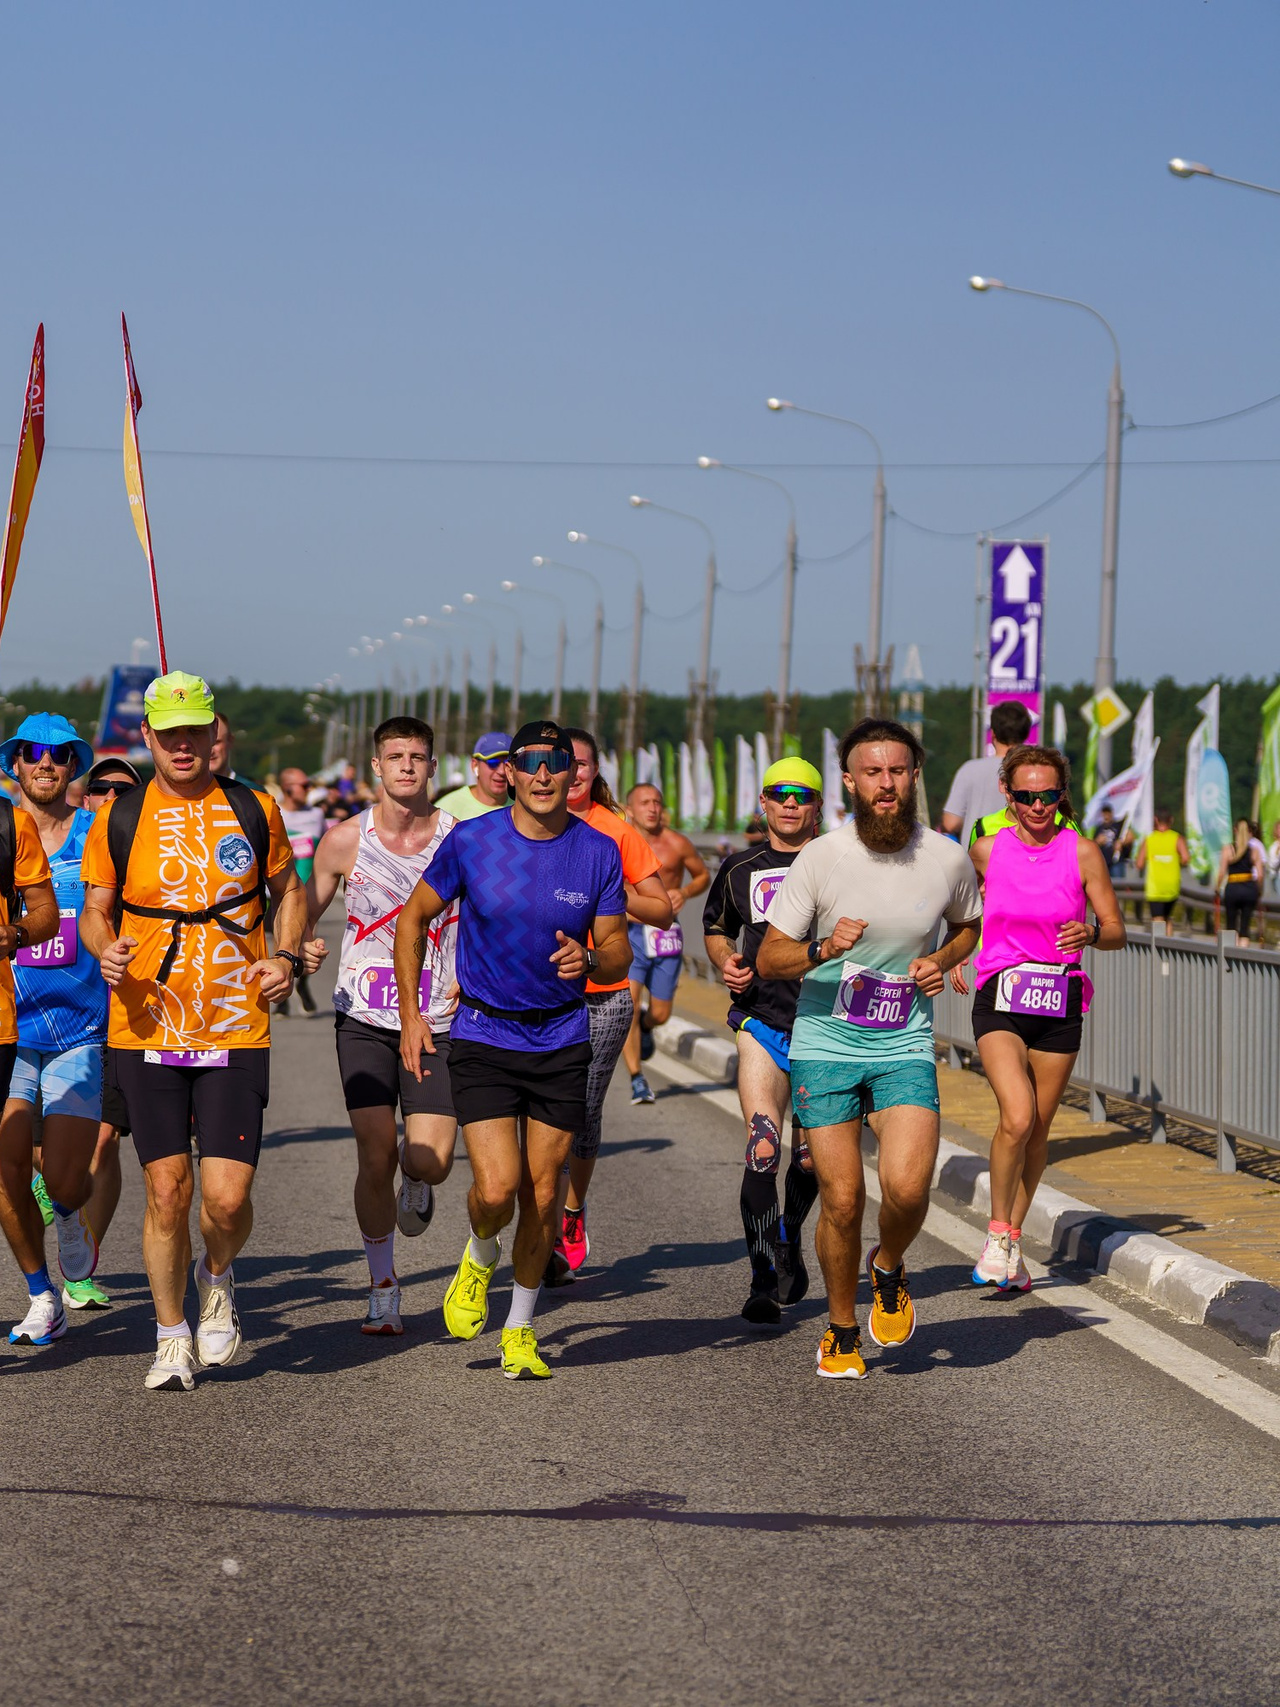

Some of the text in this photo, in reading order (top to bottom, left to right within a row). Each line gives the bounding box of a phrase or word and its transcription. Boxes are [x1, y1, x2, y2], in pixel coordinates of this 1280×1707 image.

[990, 615, 1038, 679] 21
[154, 807, 189, 974] КАЛЖСКИЙ
[874, 986, 902, 999] СЕРГЕЙ
[1030, 976, 1055, 988] МАРИЯ
[381, 985, 423, 1008] 125
[1020, 987, 1062, 1011] 4849
[865, 997, 902, 1022] 500
